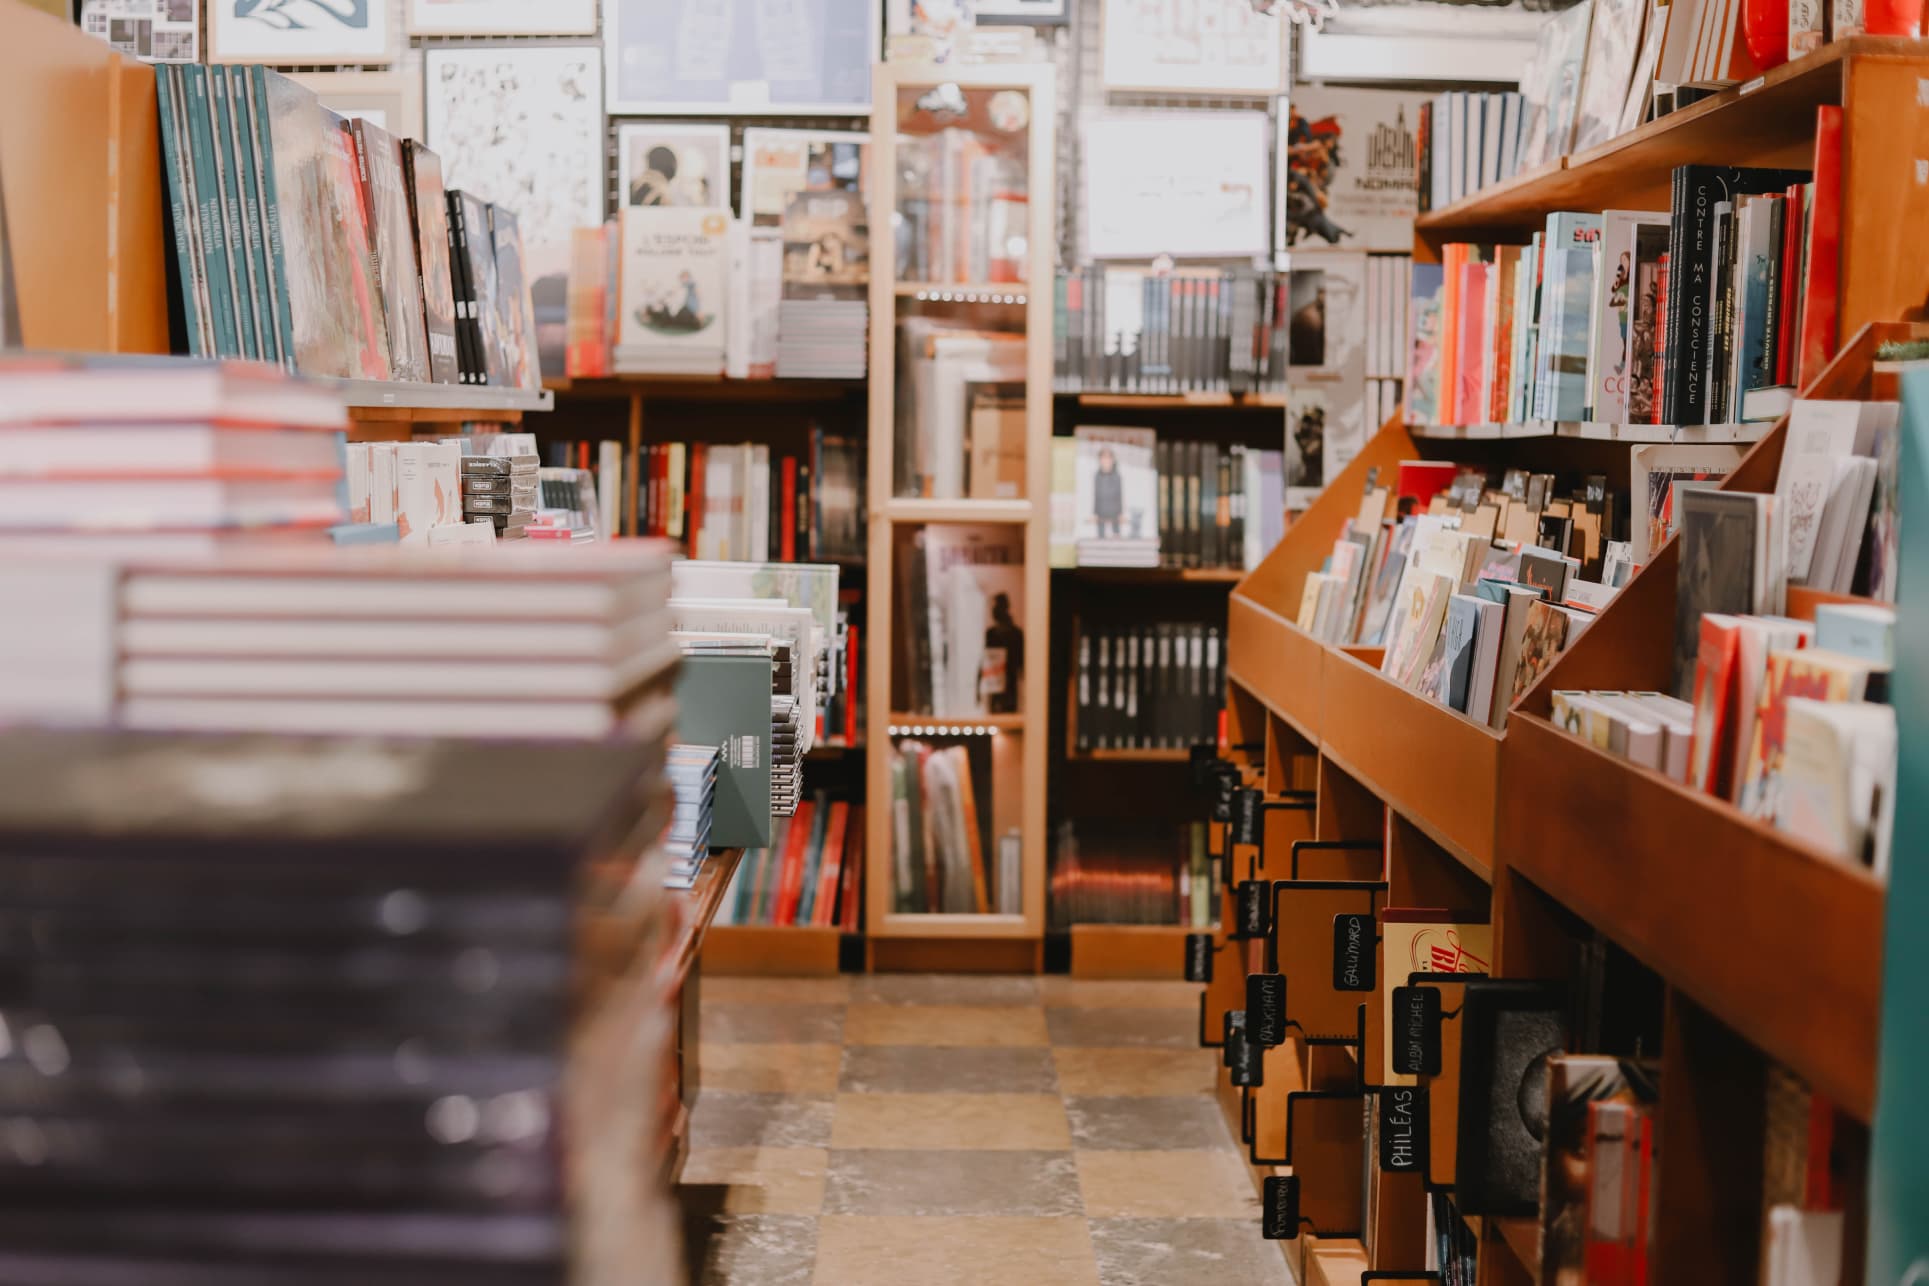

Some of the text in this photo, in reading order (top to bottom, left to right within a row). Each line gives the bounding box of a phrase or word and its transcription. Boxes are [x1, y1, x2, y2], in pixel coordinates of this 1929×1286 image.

[1689, 185, 1708, 404] CONTRE MA CONSCIENCE
[1389, 1090, 1413, 1167] PHILÉAS
